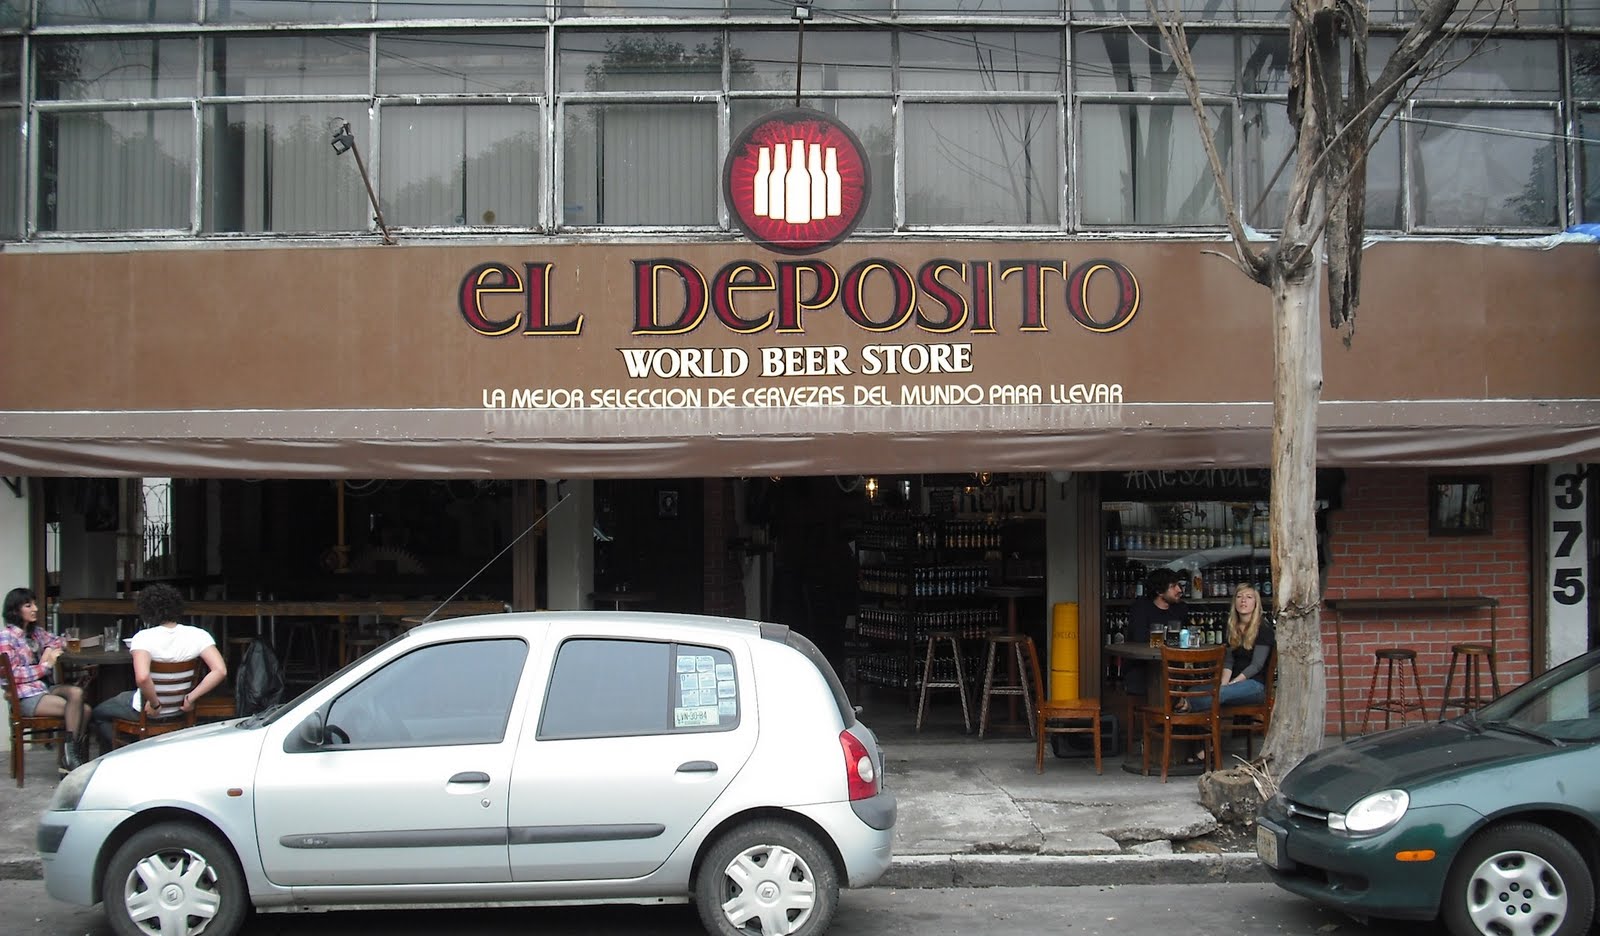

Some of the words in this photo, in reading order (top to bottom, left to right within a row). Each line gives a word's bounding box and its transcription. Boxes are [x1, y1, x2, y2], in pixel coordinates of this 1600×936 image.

[617, 347, 750, 378] WORLD
[758, 345, 855, 376] BEER
[861, 343, 974, 375] STORE
[482, 388, 506, 408] LA
[512, 388, 584, 408] MEJOR
[590, 388, 702, 409] SELECCION
[709, 387, 736, 407] DE
[741, 386, 846, 408] CERVEZAS
[854, 385, 892, 406] DEL
[901, 384, 985, 405] MUNDO
[989, 384, 1042, 405] PARA
[1050, 383, 1123, 404] LLEVAR
[1553, 473, 1586, 606] 375
